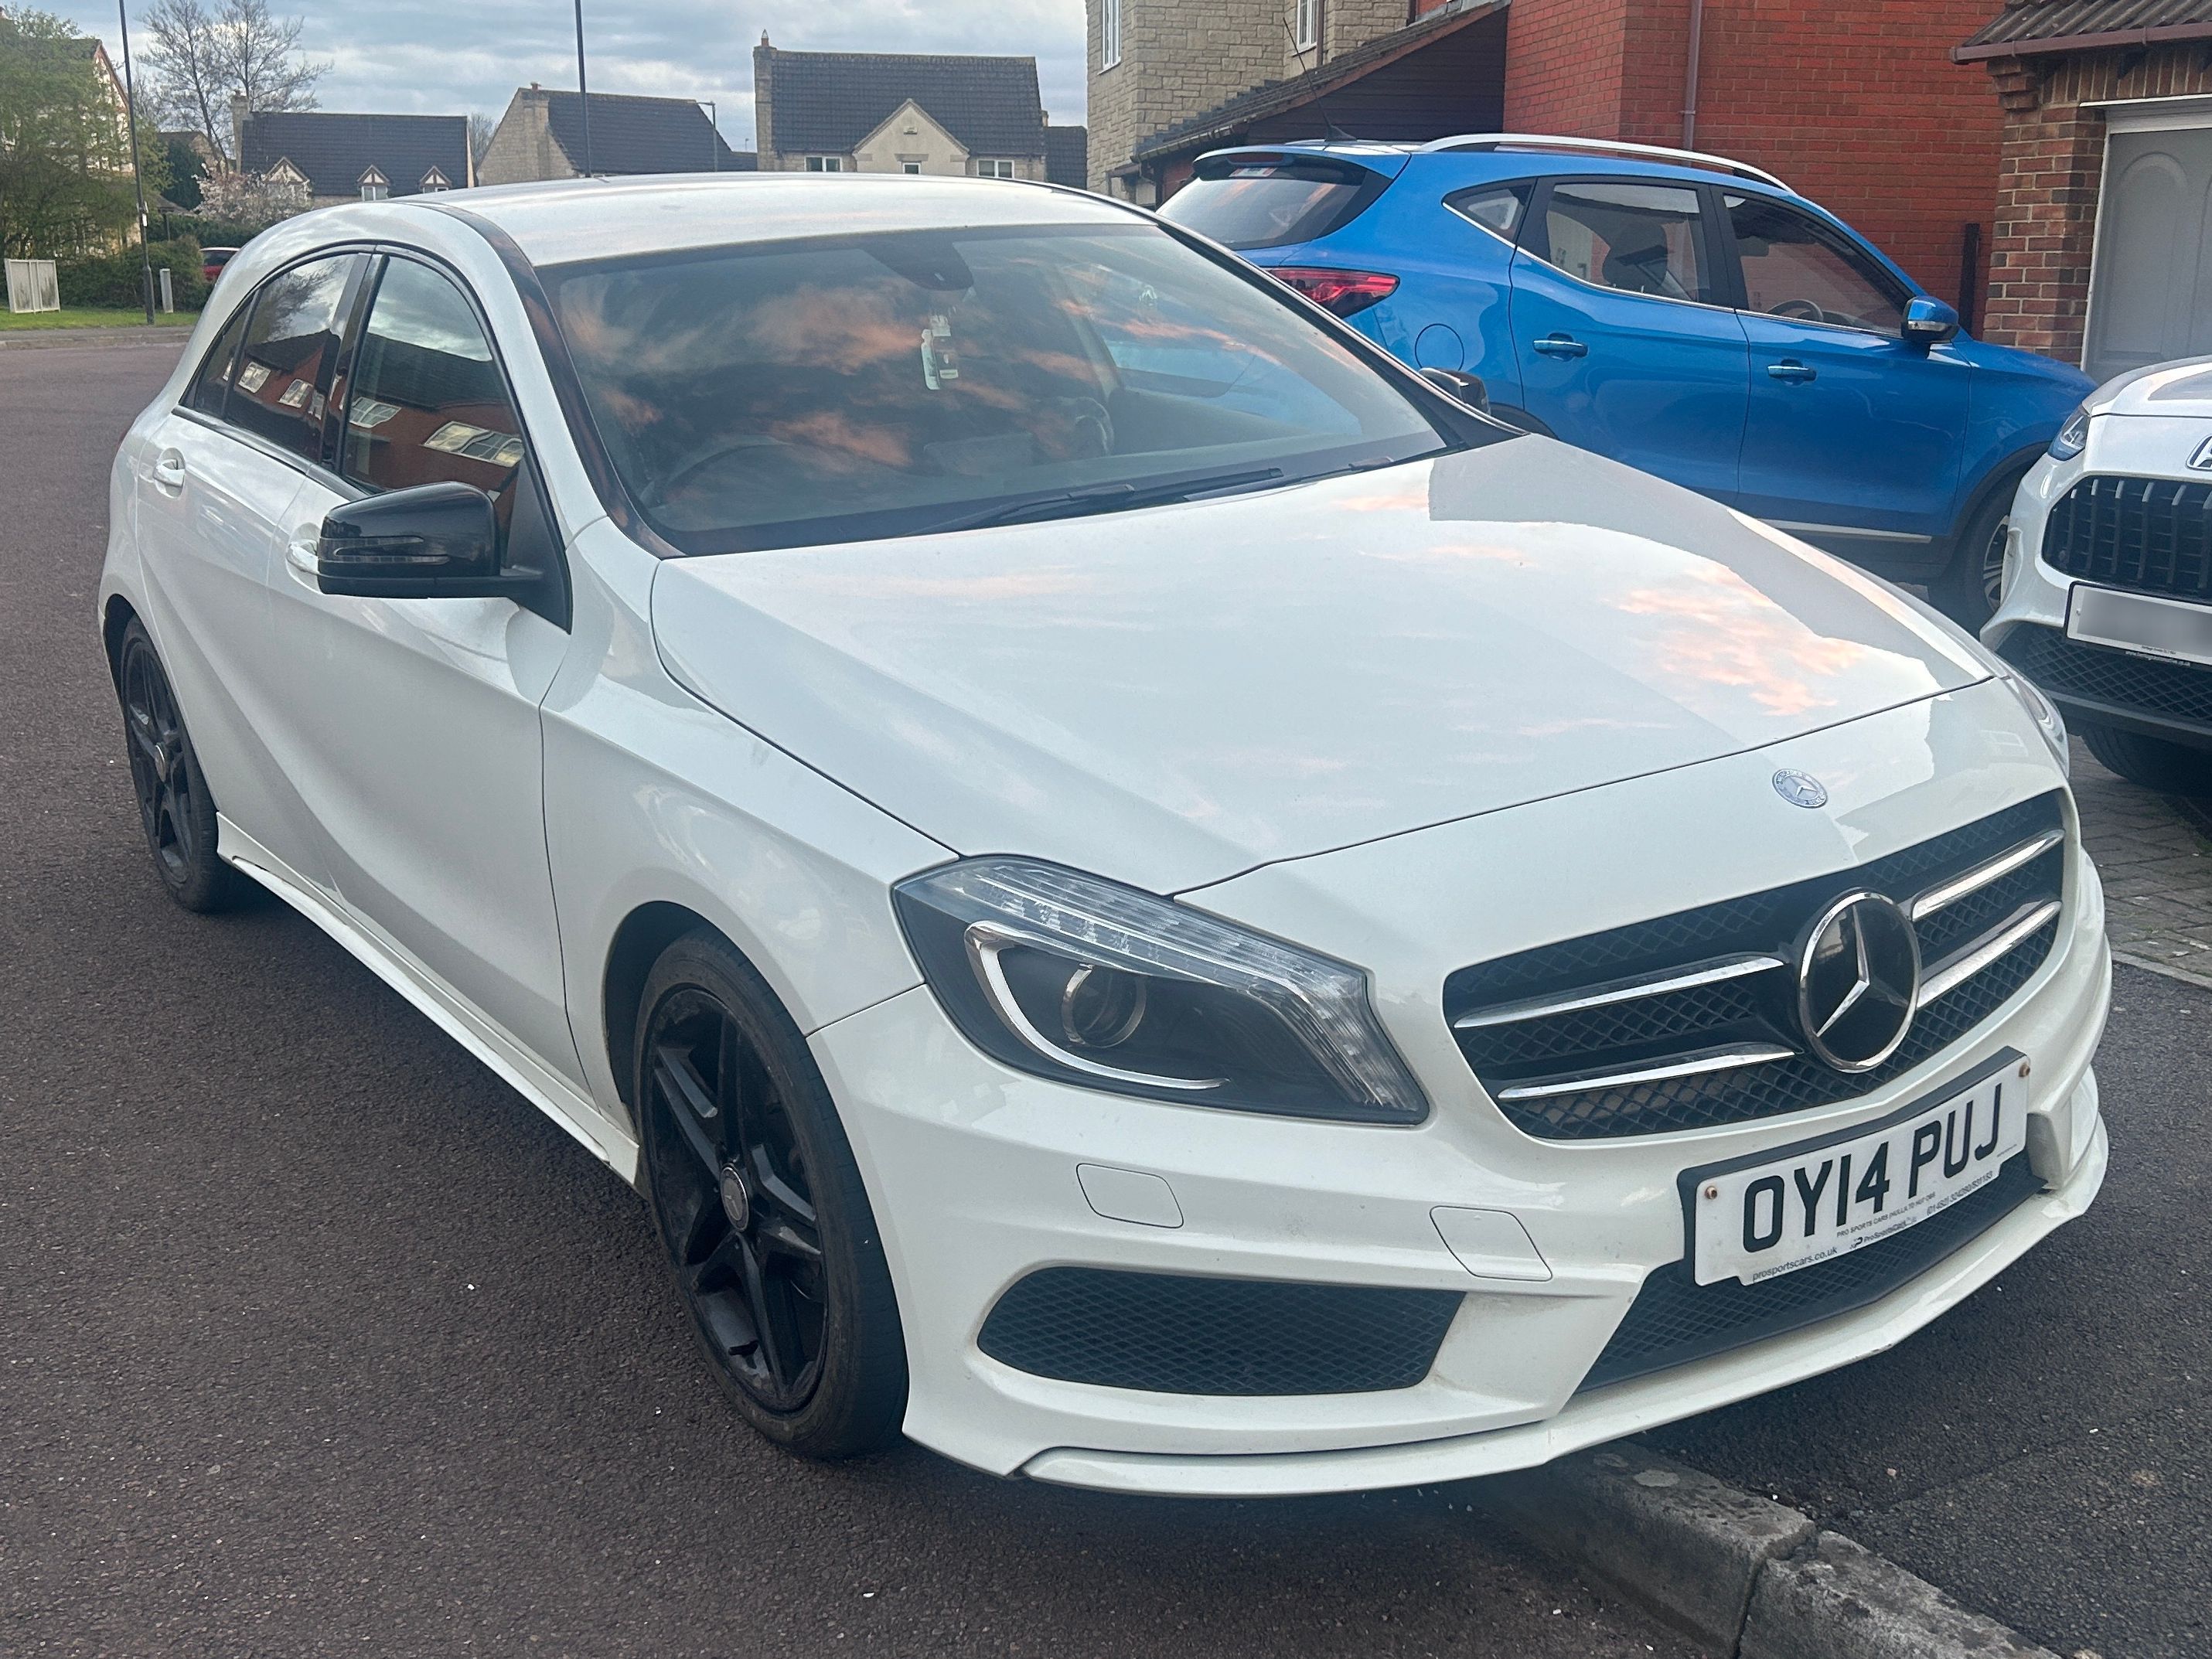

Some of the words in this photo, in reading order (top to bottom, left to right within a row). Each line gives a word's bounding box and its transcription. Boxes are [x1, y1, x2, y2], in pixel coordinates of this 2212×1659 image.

[1743, 1141, 1890, 1253] OY14
[1907, 1082, 2002, 1199] PUJ
[1752, 1246, 1838, 1283] prosportscars.co.uk
